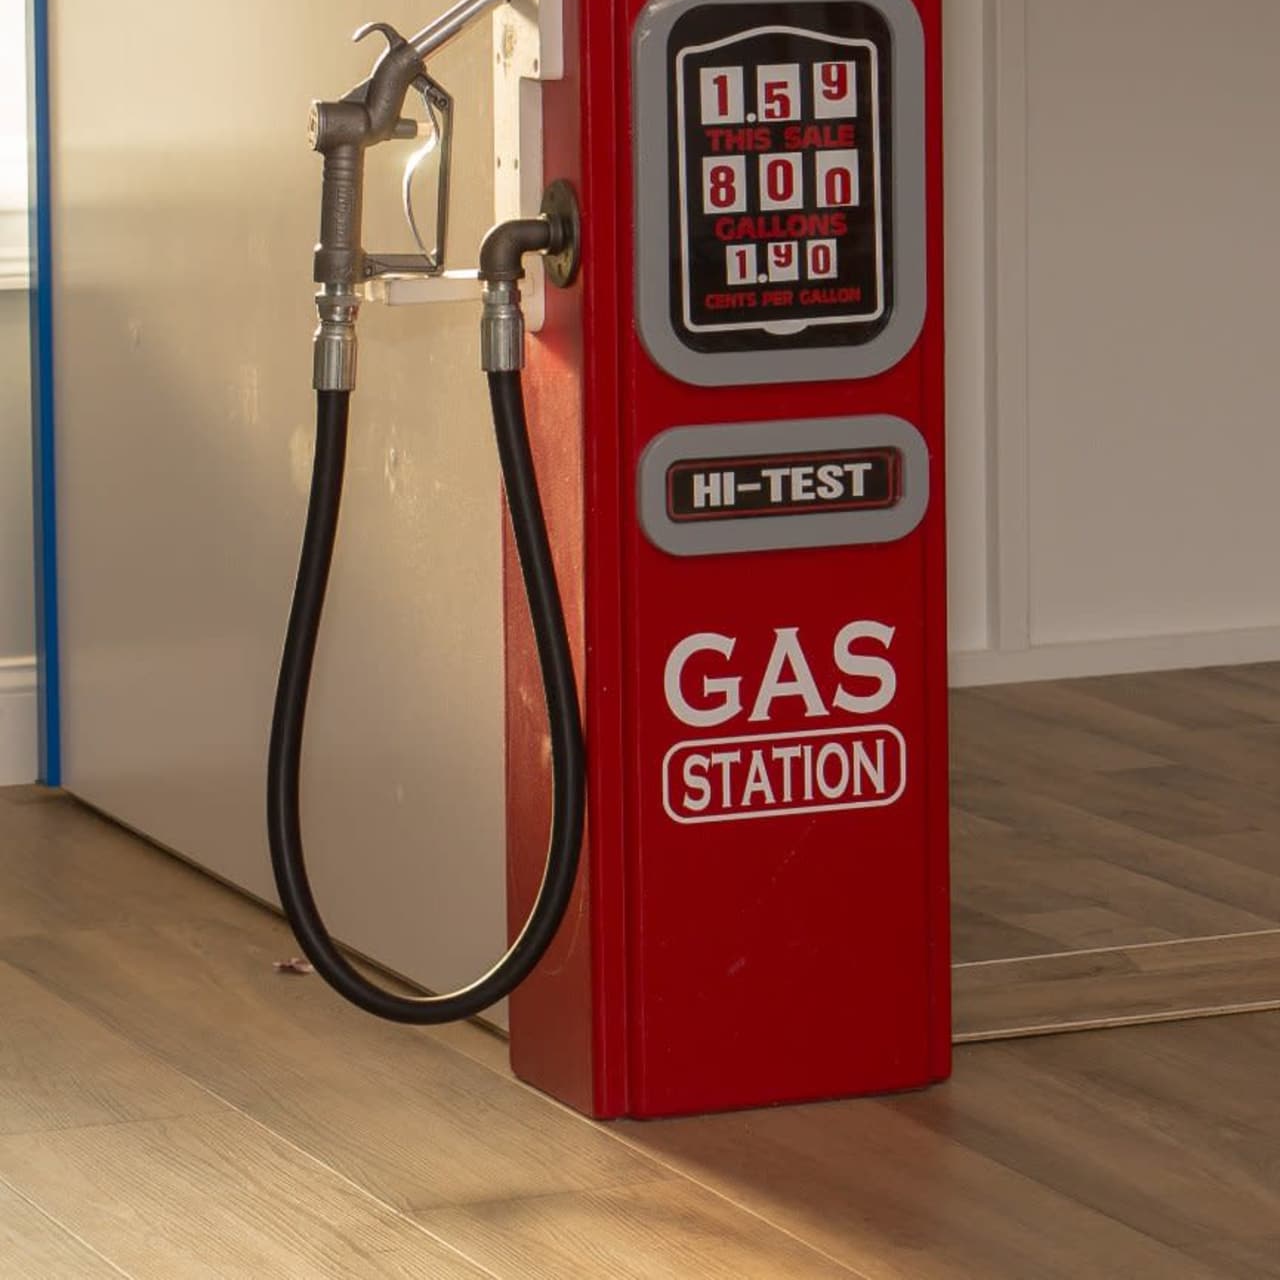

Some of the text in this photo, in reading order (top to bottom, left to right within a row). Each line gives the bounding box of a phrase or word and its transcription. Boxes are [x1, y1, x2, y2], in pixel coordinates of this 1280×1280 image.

[704, 124, 855, 152] THIS SALE
[715, 212, 848, 240] GALLONS
[704, 287, 862, 309] CENTS PER GALLON
[692, 461, 873, 509] HI-TEST
[663, 620, 897, 728] GAS
[682, 738, 885, 812] STATION
